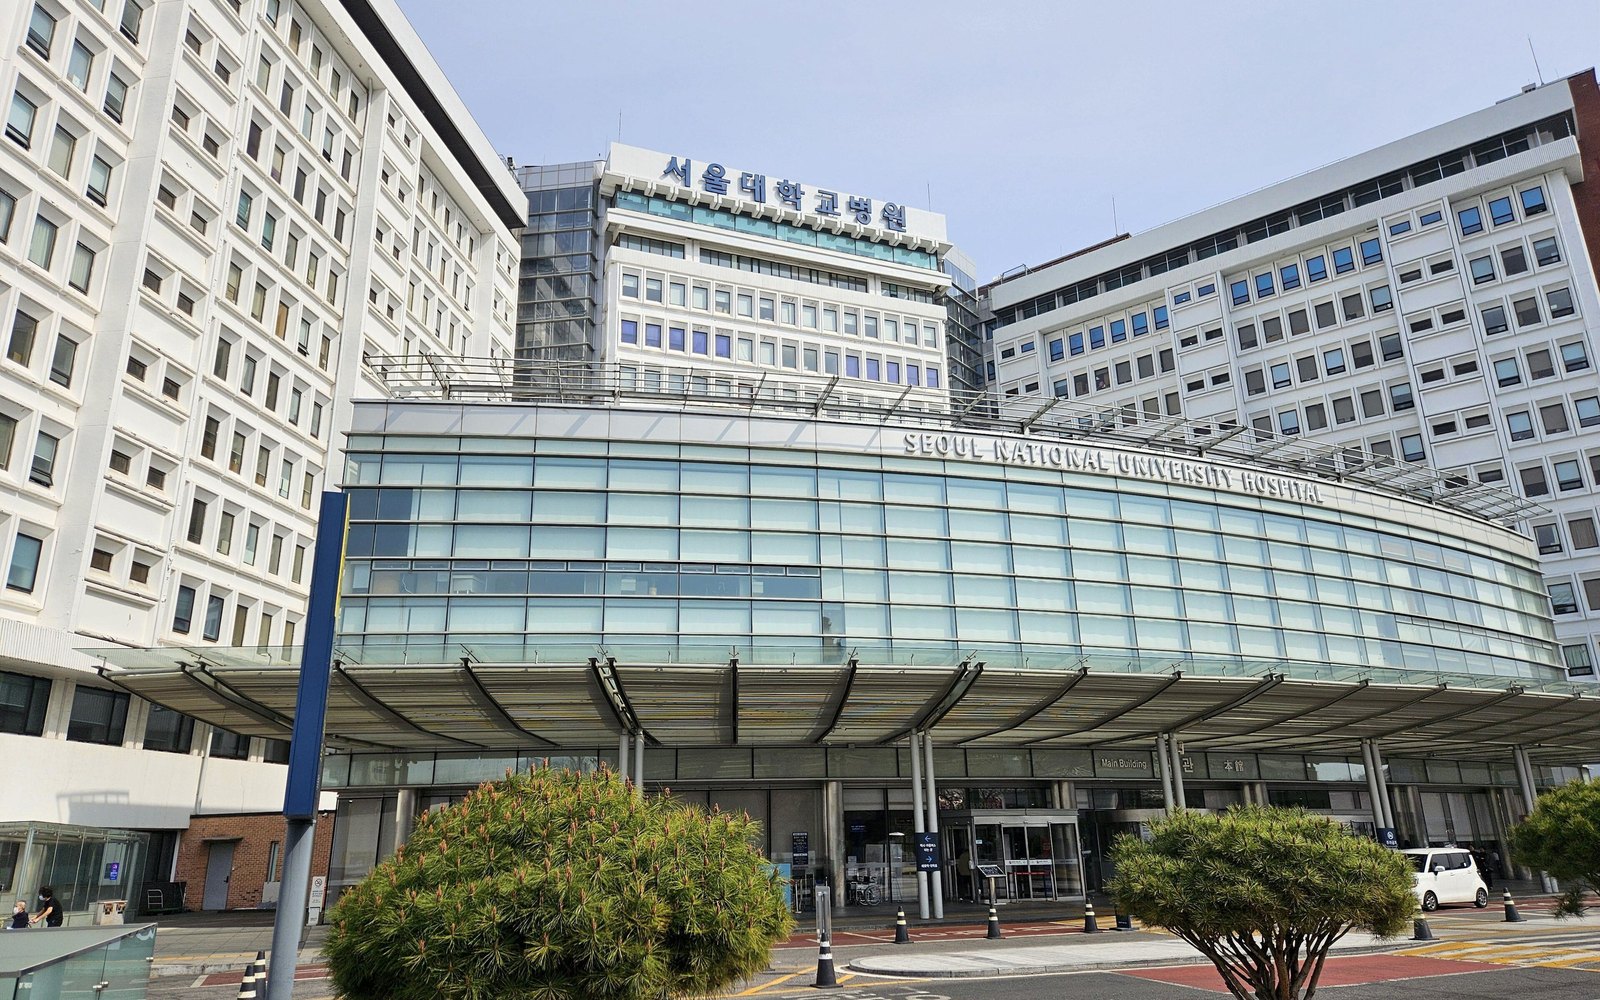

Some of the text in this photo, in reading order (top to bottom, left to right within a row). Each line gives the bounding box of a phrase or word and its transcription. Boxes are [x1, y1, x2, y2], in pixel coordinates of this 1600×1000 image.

[664, 156, 907, 232] 서울대학교병원
[903, 432, 1326, 504] SEOUL NATIONAL UNIVERSITY HOSPITAL
[1101, 758, 1147, 770] Main Building
